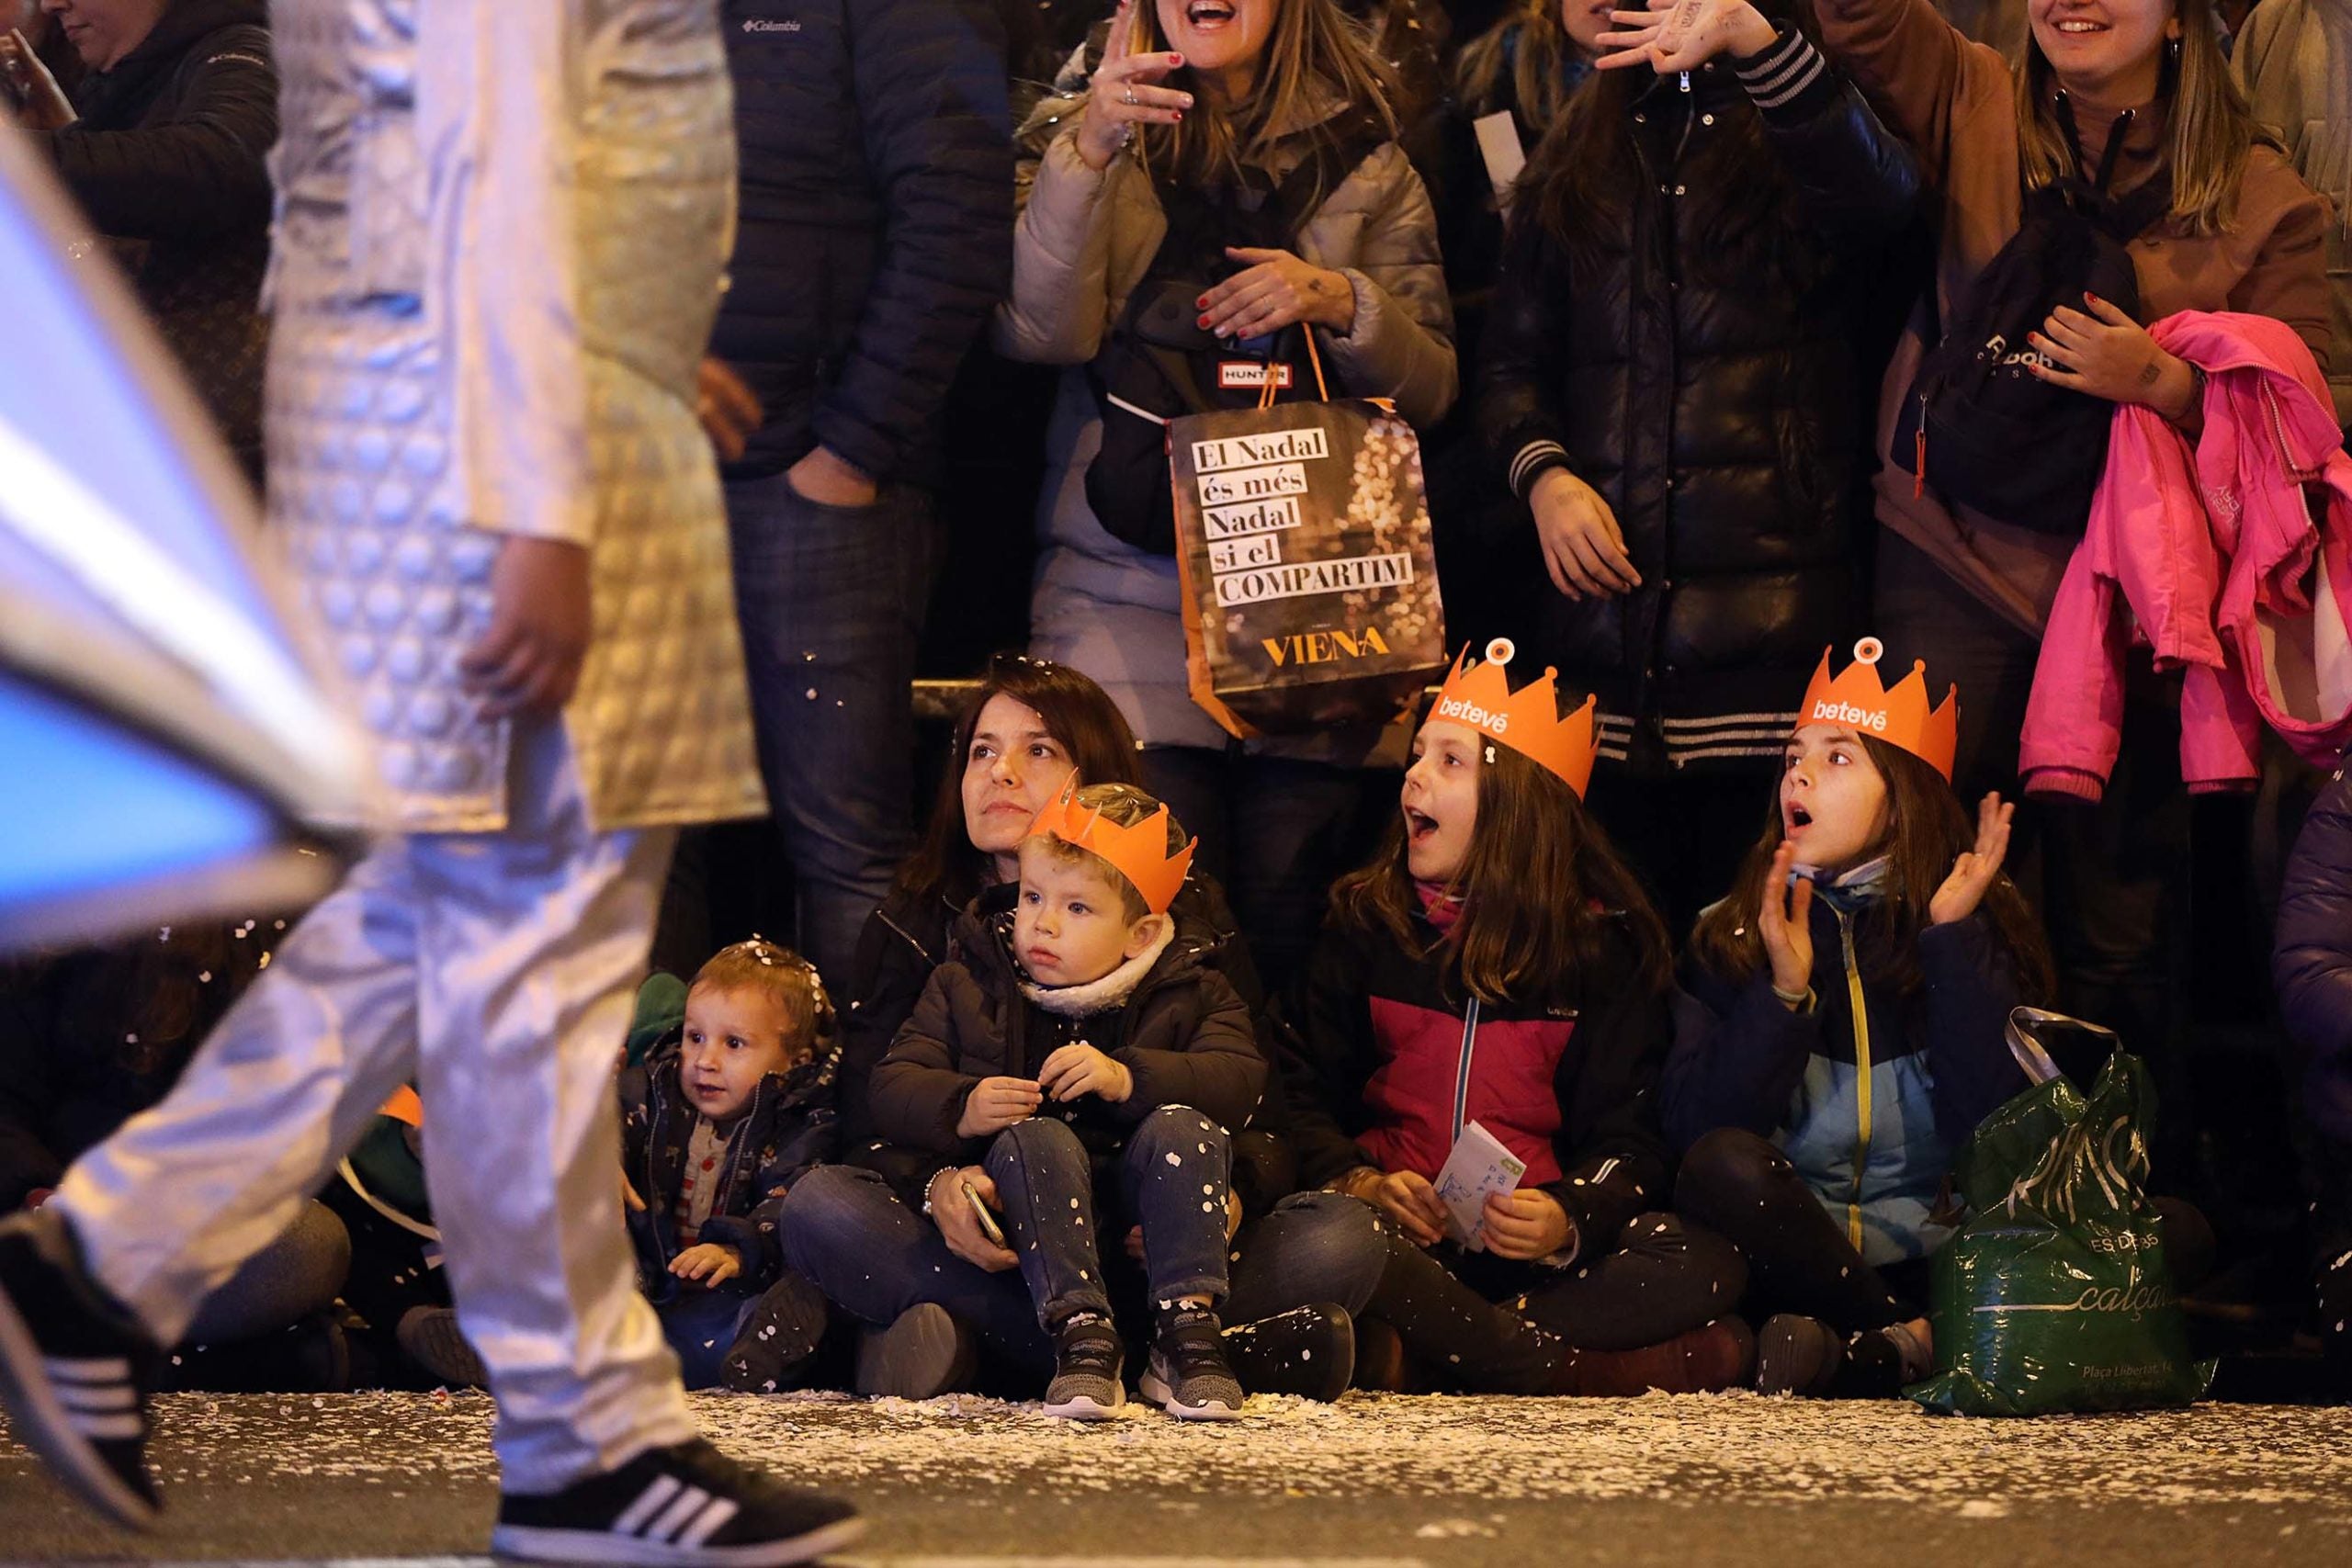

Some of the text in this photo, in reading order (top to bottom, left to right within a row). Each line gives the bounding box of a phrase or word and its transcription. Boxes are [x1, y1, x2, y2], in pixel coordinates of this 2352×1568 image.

[753, 20, 801, 31] Columbia
[1198, 432, 1324, 469] El Nadal
[1204, 468, 1303, 502] és més
[1208, 502, 1295, 536] Nadal
[1214, 539, 1273, 570] si el
[1219, 557, 1408, 603] COMPARTIM
[1261, 626, 1391, 667] VIENA
[1439, 695, 1509, 735] betevé
[1812, 700, 1887, 733] betevé
[2082, 1364, 2111, 1380] Plaça
